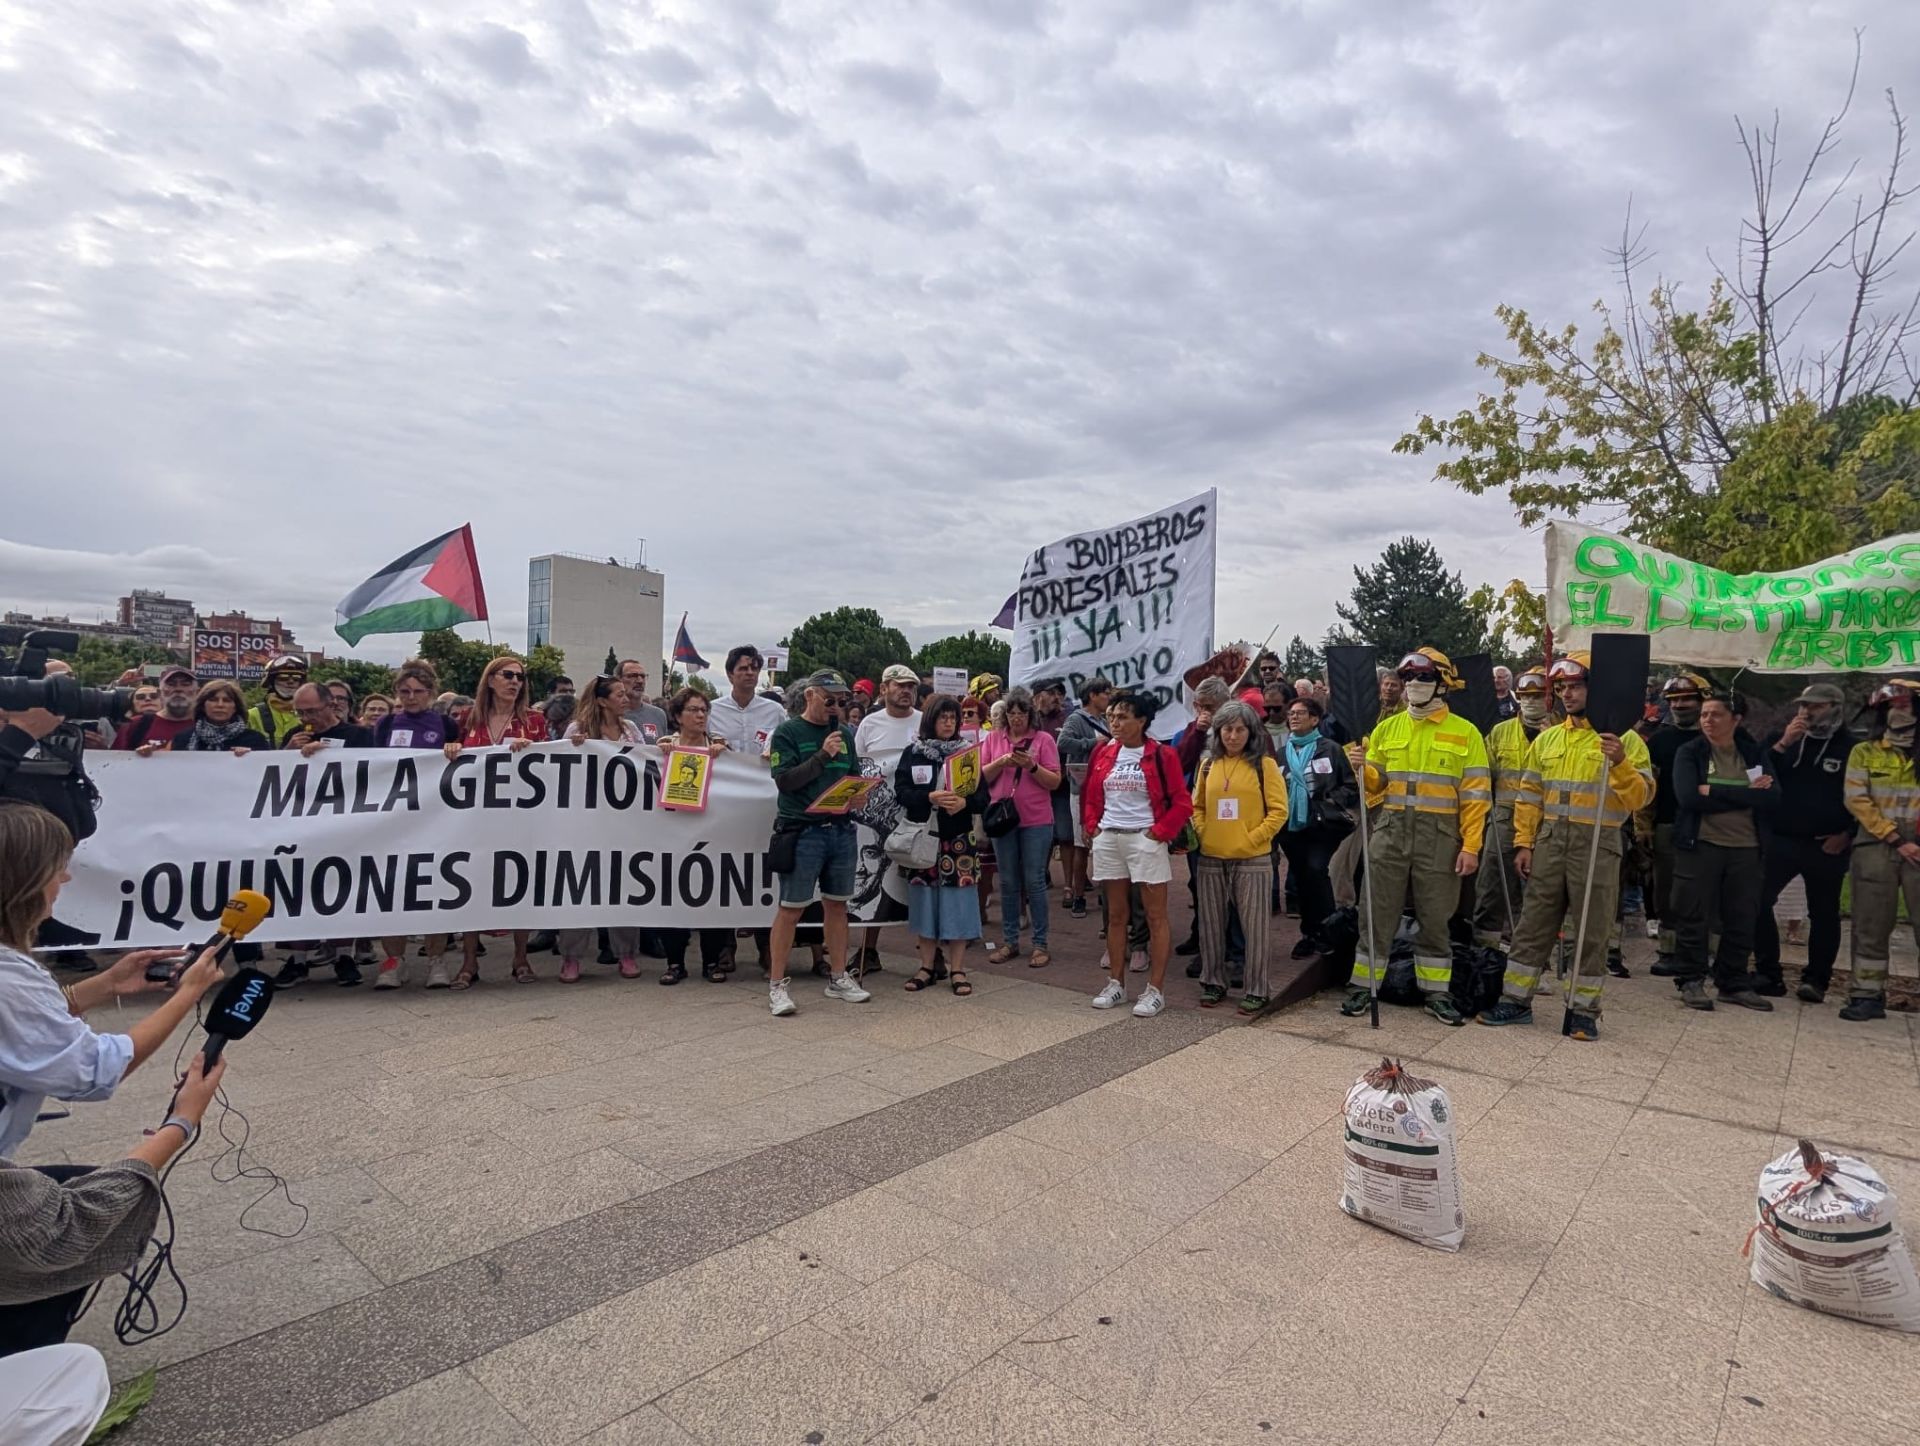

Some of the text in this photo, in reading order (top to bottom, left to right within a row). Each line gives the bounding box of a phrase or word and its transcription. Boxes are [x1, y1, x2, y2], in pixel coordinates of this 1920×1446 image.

[1065, 504, 1207, 571] BOMBEROS
[1018, 552, 1180, 622] FORESTALES
[1567, 580, 1634, 627] EL
[197, 634, 232, 648] SOS
[240, 637, 275, 651] SOS
[250, 757, 420, 818] MALA
[114, 842, 774, 941] ¡QUIÑONES DIMISIÓN!
[224, 978, 266, 1023] vive!
